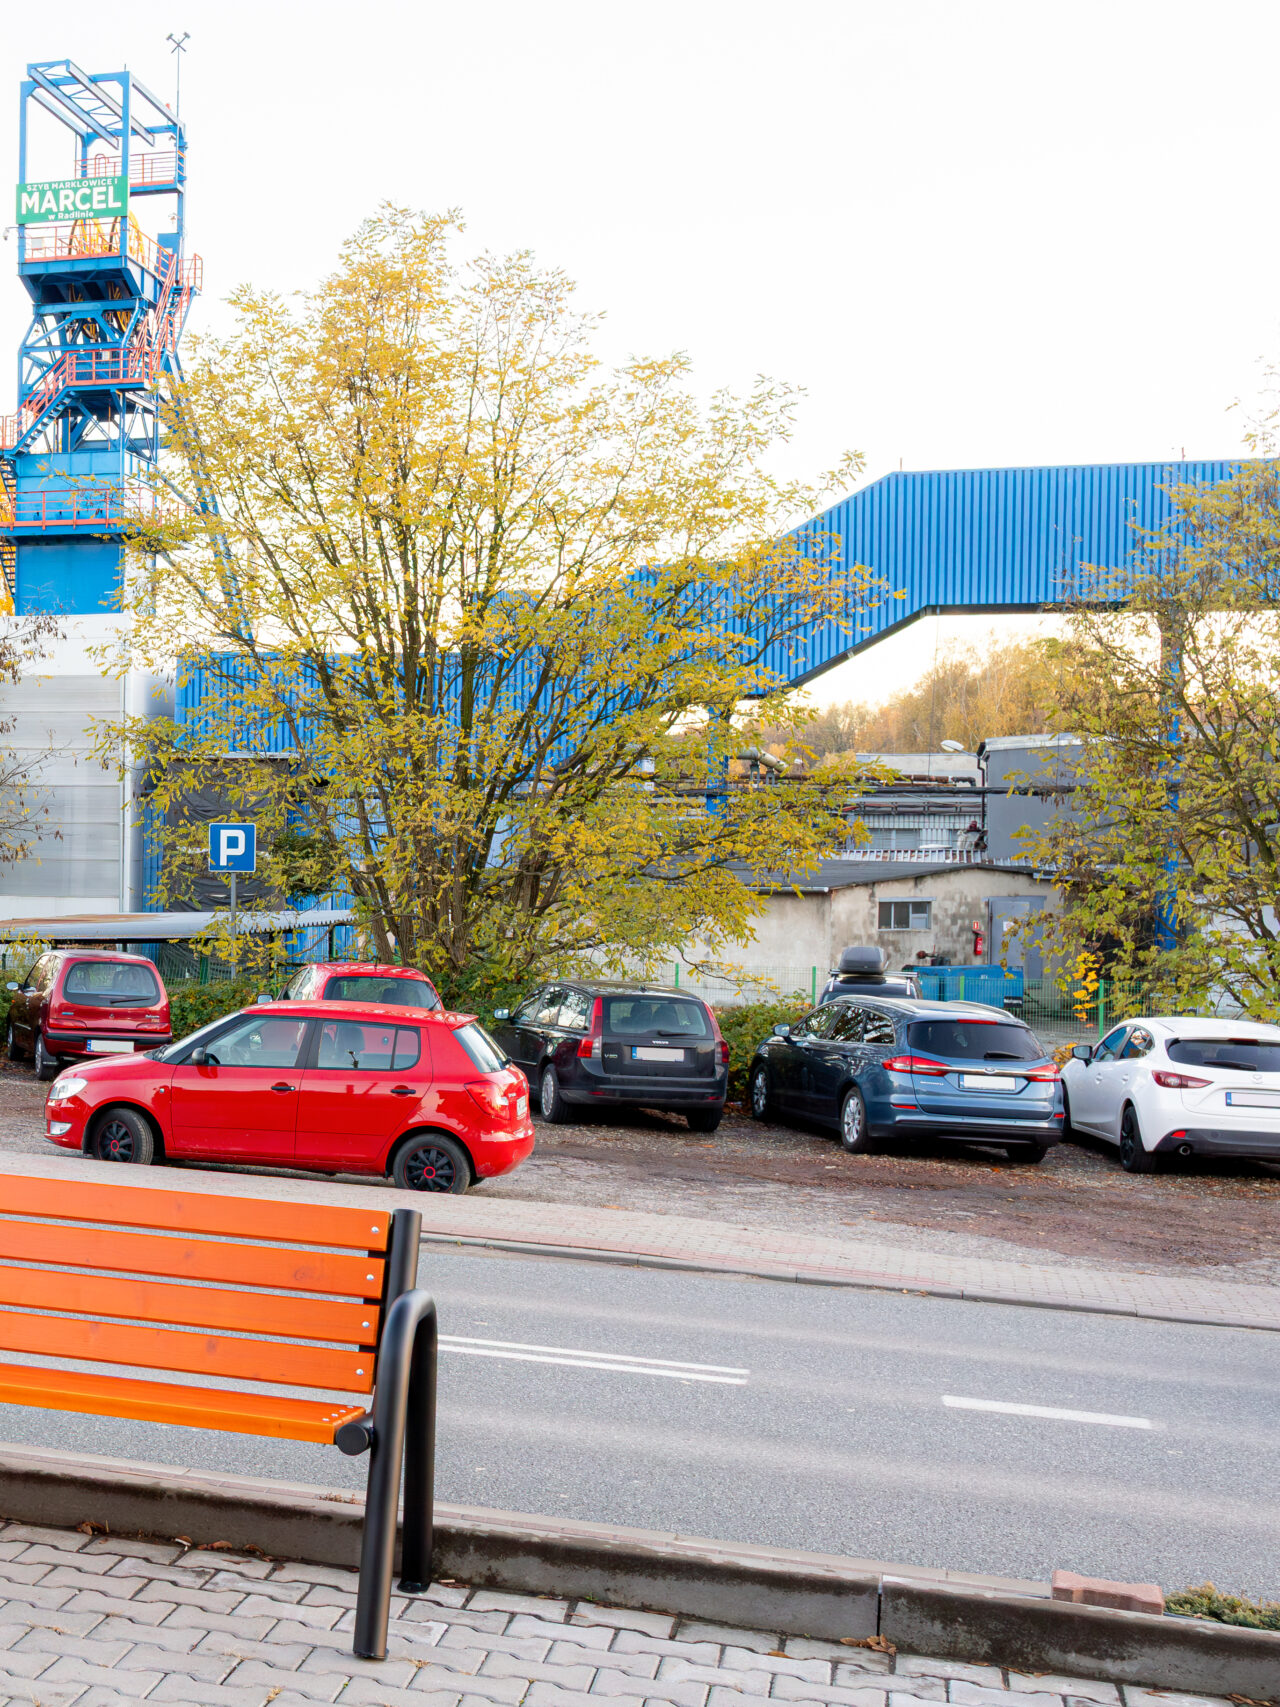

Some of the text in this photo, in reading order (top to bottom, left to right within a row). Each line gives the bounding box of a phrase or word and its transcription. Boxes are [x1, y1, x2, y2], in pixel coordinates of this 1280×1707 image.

[26, 183, 50, 191] SZYB
[51, 178, 113, 190] MARKLOWICE
[21, 186, 122, 215] MARCEL
[57, 210, 94, 219] Radlinie
[220, 829, 245, 866] P
